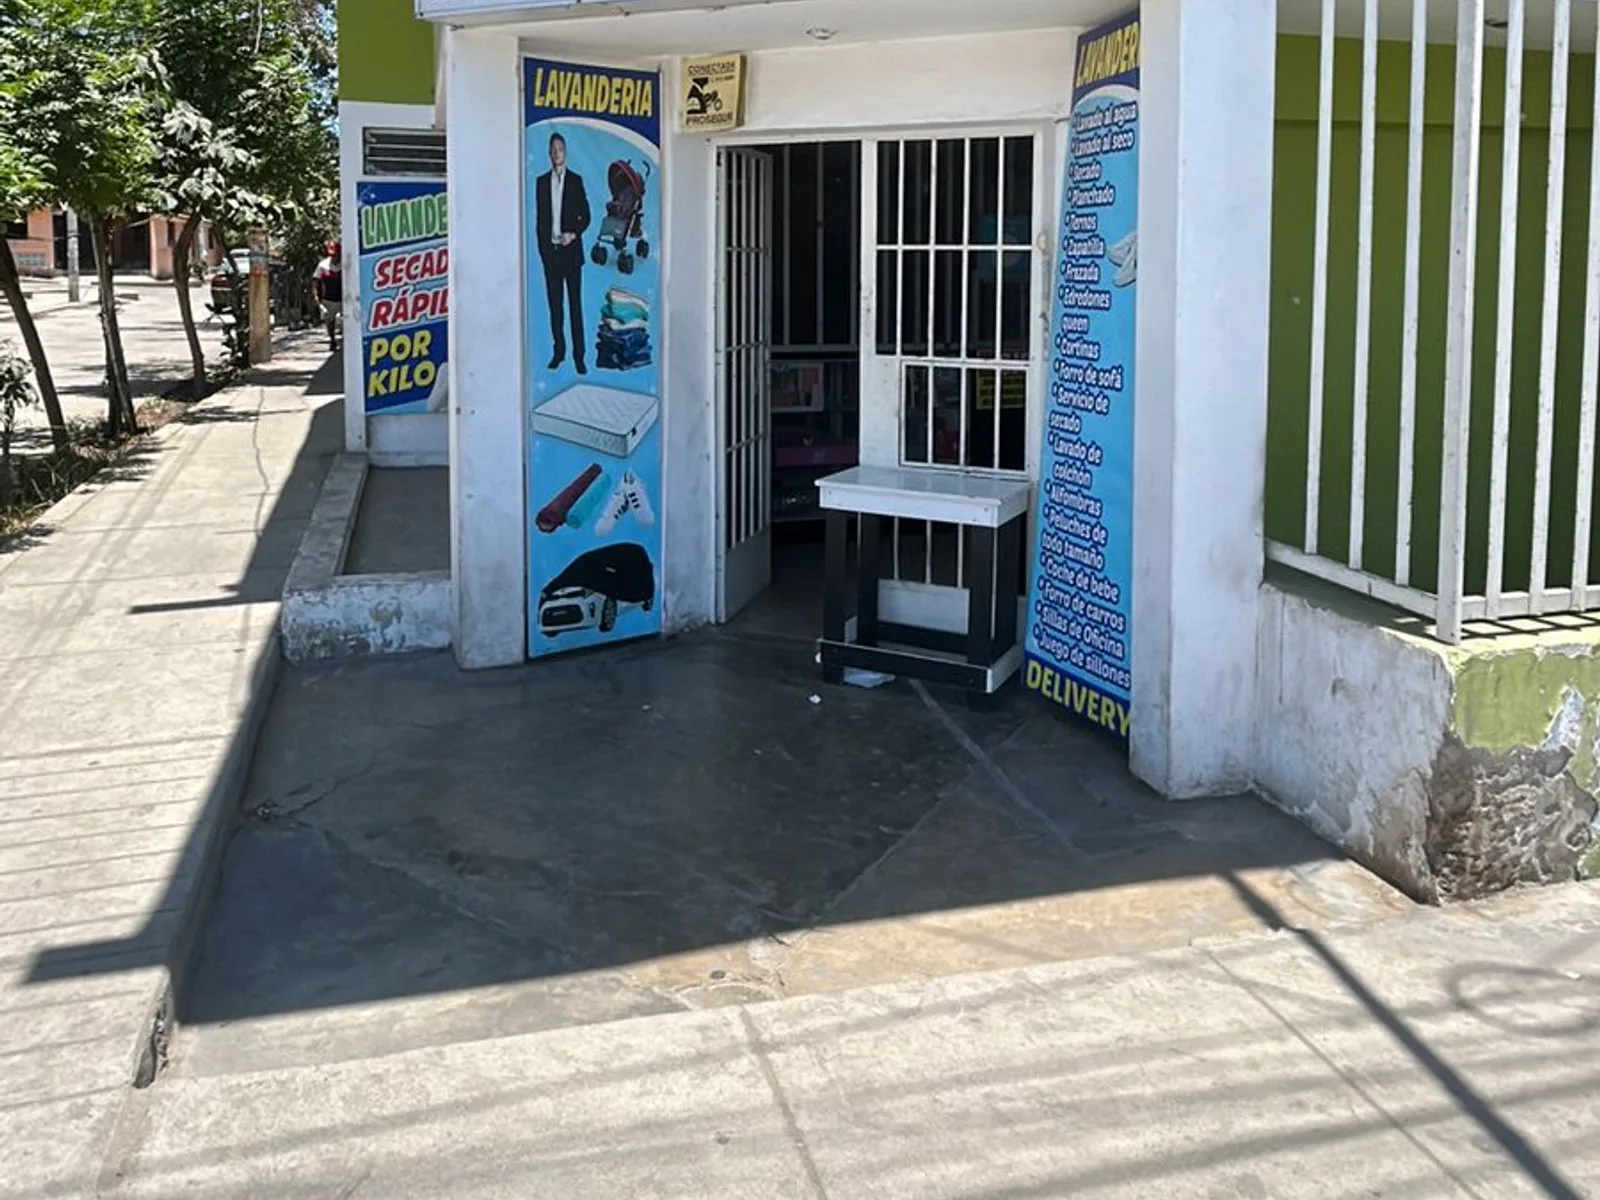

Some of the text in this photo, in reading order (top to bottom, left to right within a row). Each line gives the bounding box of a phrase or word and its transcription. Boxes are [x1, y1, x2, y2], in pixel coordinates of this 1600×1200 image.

[534, 68, 652, 117] LAVANDERIA
[1076, 103, 1137, 130] Lavado al agua
[1075, 132, 1133, 157] Lavado al seco
[1073, 162, 1100, 180] Secado
[1071, 187, 1114, 206] Planchado
[362, 192, 449, 248] LAVANDE
[1070, 214, 1096, 231] Ternos
[374, 246, 449, 290] SECAD
[1064, 265, 1099, 282] Frazada
[1063, 290, 1110, 309] Edredones
[1062, 315, 1088, 332] queen
[370, 330, 432, 366] POR
[1061, 337, 1099, 358] Cortinas
[368, 360, 436, 397] KILO
[1059, 363, 1122, 389] Forro de sofá
[1057, 387, 1109, 413] Servicio de
[1050, 412, 1080, 431] secado
[1053, 437, 1102, 464] Lavado de
[1051, 485, 1101, 517] Alfombras
[1049, 508, 1107, 544] Peluches de
[1042, 532, 1104, 569] todo tamaño
[1047, 557, 1119, 603] Coche de bebe
[1045, 580, 1124, 632] Forro de carros
[1041, 605, 1123, 659] Sillas de Oficina
[1040, 631, 1131, 689] Juego de sillones
[1026, 659, 1132, 736] DELIVERY
